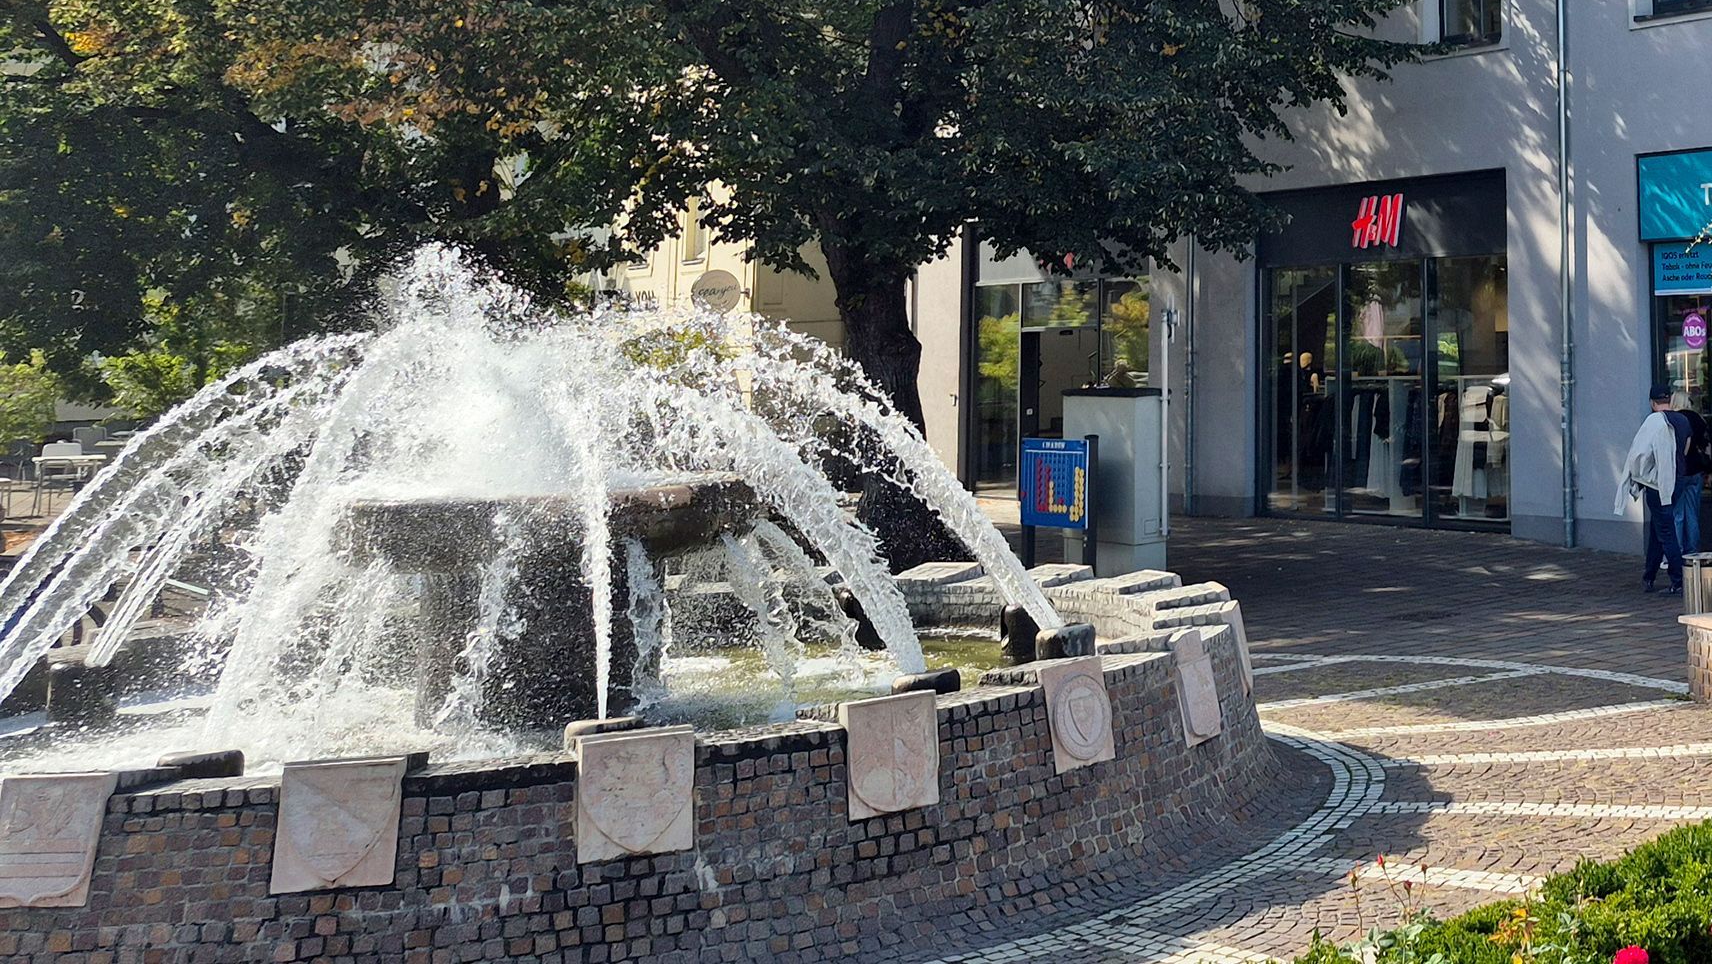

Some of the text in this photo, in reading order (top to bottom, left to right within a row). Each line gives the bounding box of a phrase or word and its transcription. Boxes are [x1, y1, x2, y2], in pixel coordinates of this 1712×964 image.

[1352, 193, 1404, 249] H&M
[1661, 252, 1677, 260] IQOS
[1662, 263, 1680, 271] Tabak
[1681, 273, 1694, 281] oder
[1683, 325, 1706, 337] ABOs
